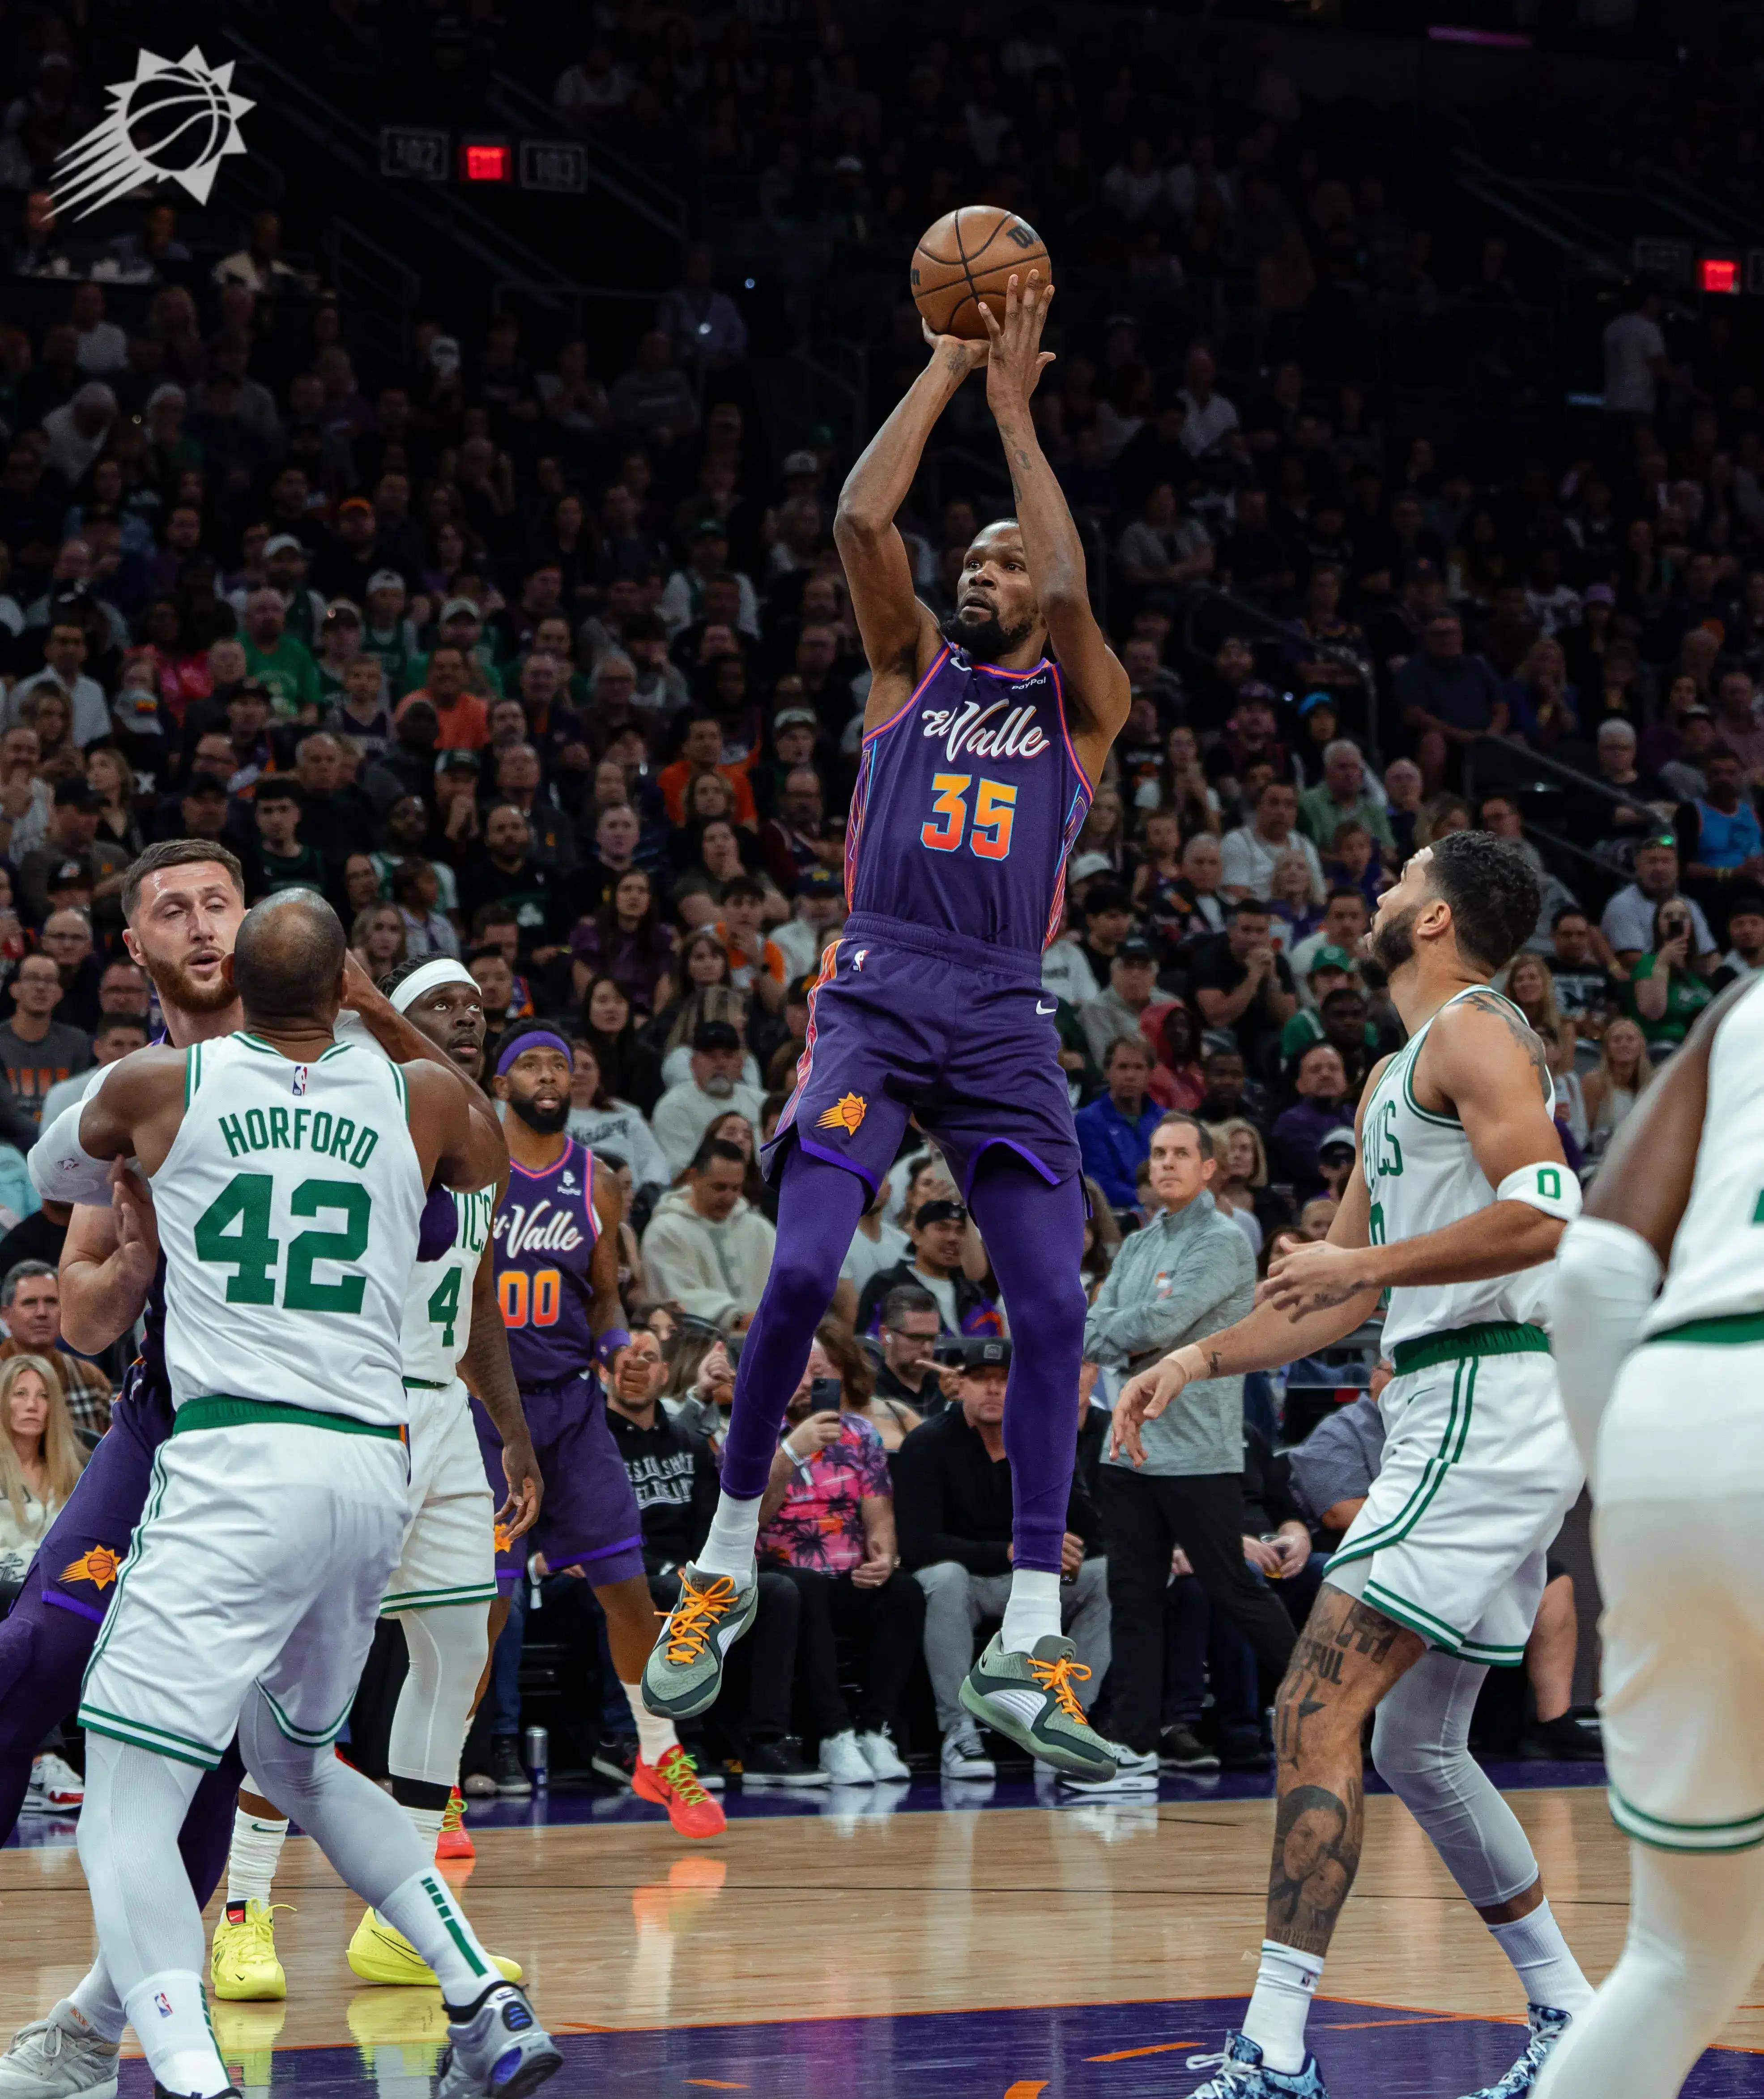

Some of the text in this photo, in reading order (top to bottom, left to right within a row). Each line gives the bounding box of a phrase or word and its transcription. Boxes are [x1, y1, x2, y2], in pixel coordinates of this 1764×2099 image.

[946, 698, 1050, 762] Valle
[920, 773, 1018, 861] 35
[218, 1107, 379, 1170] HORFORD
[1537, 1169, 1561, 1200] 0
[194, 1173, 372, 1315] 42
[507, 1199, 584, 1259] Valle
[428, 1267, 462, 1348] 4
[498, 1269, 561, 1329] 00
